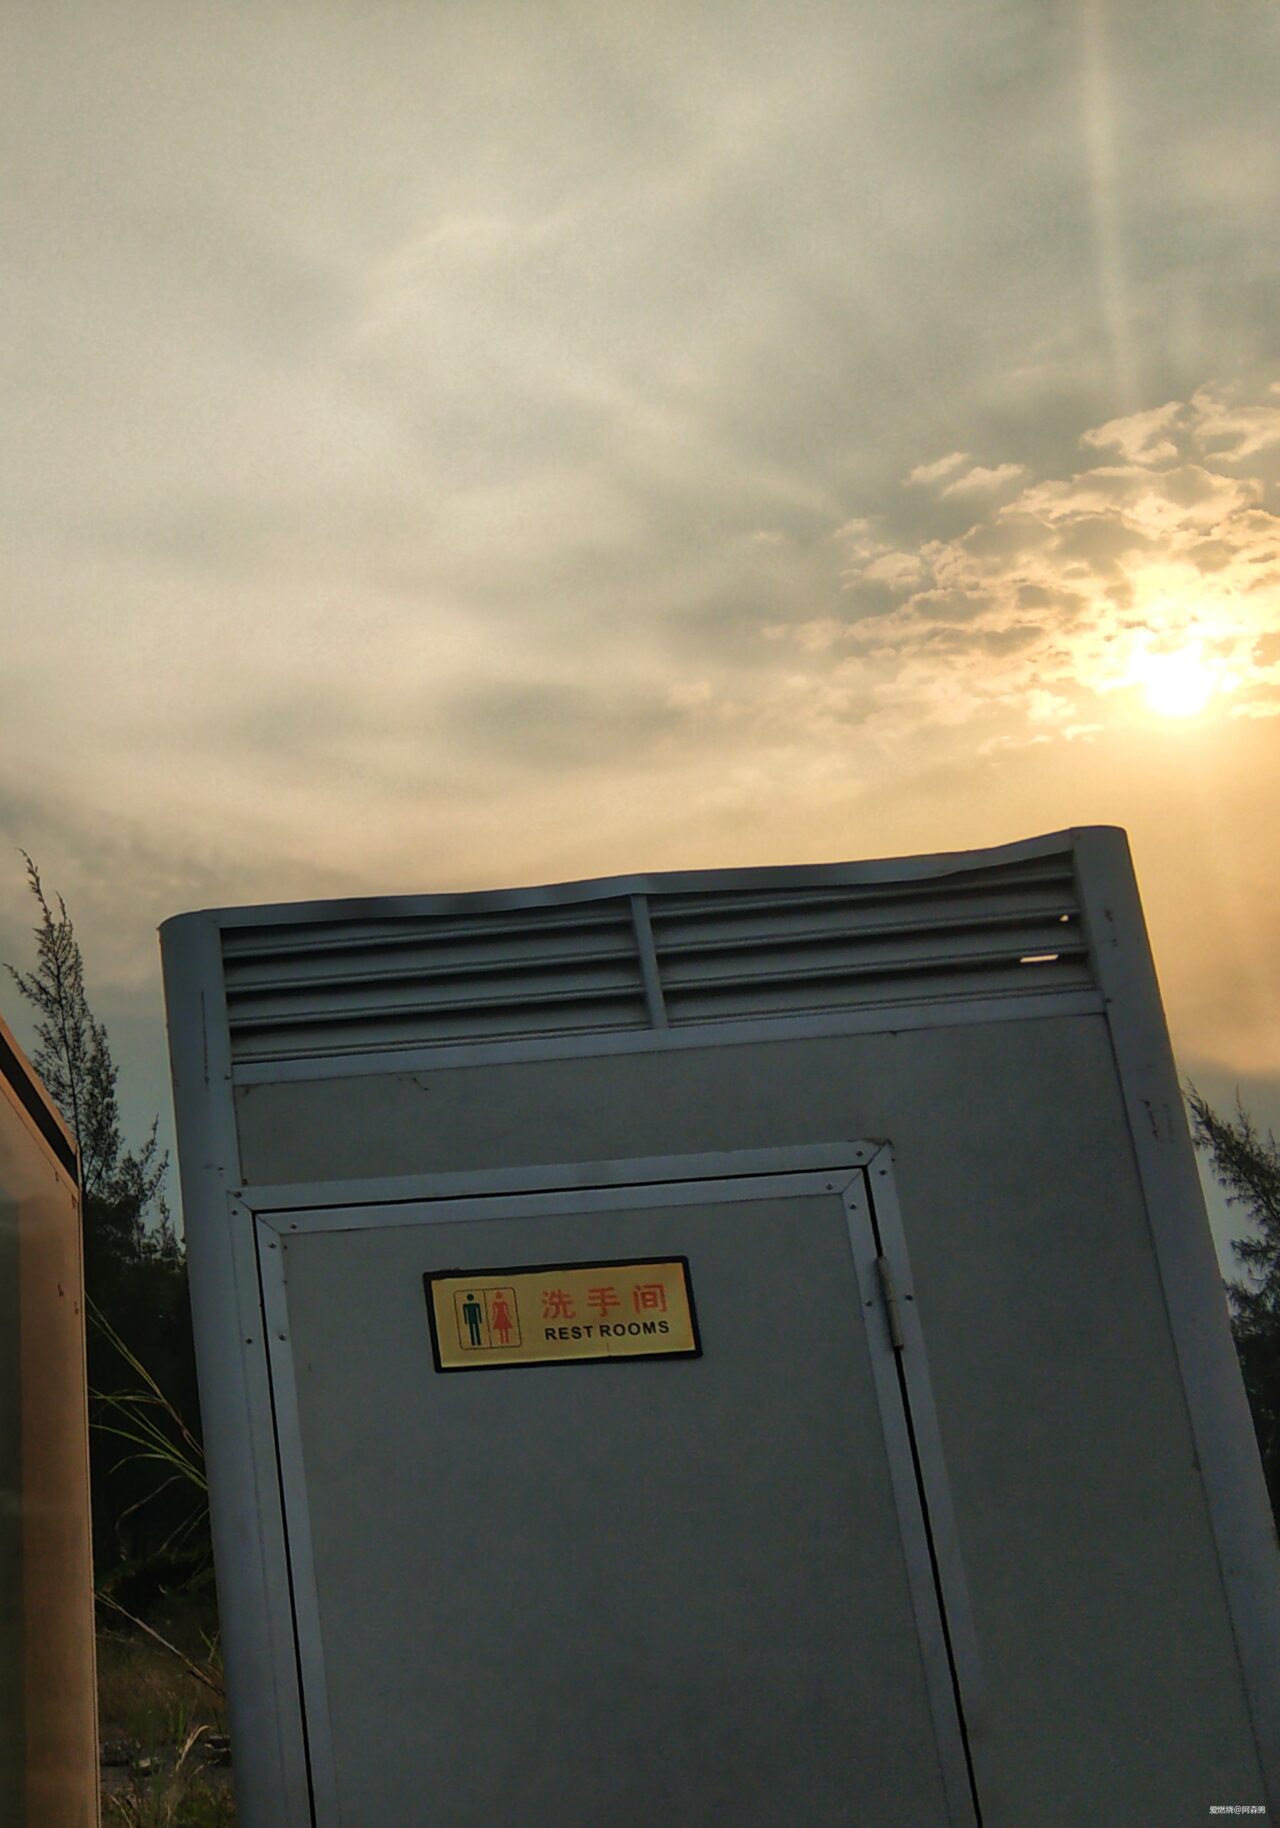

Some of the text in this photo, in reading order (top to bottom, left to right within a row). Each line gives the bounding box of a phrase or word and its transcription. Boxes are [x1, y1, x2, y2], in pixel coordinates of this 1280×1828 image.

[541, 1284, 669, 1320] 洗手间
[545, 1320, 670, 1341] REST ROOMS
